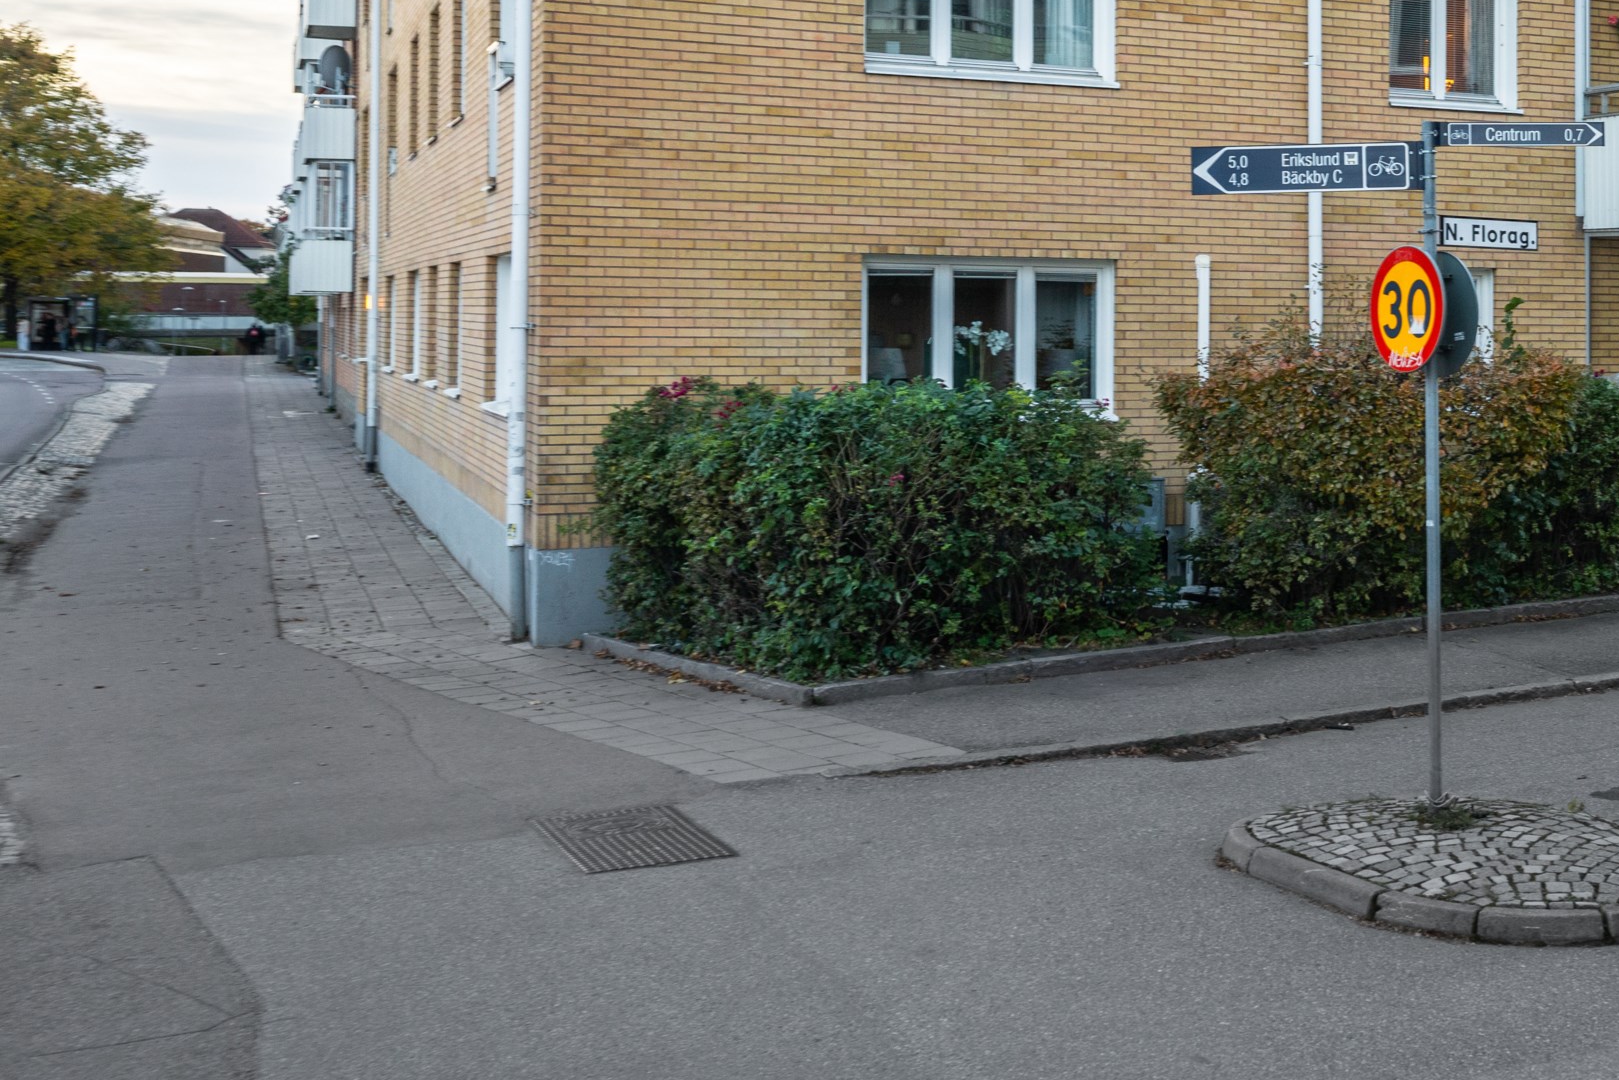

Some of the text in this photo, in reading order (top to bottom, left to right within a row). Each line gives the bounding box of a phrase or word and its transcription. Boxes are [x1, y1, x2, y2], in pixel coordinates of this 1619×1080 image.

[1485, 127, 1585, 143] Centrum 0,7
[1228, 151, 1341, 170] 5,0 Erikslund
[1228, 169, 1343, 187] 4,8 Bäckby C
[1445, 222, 1536, 249] N. Florag.
[1382, 278, 1432, 339] 30
